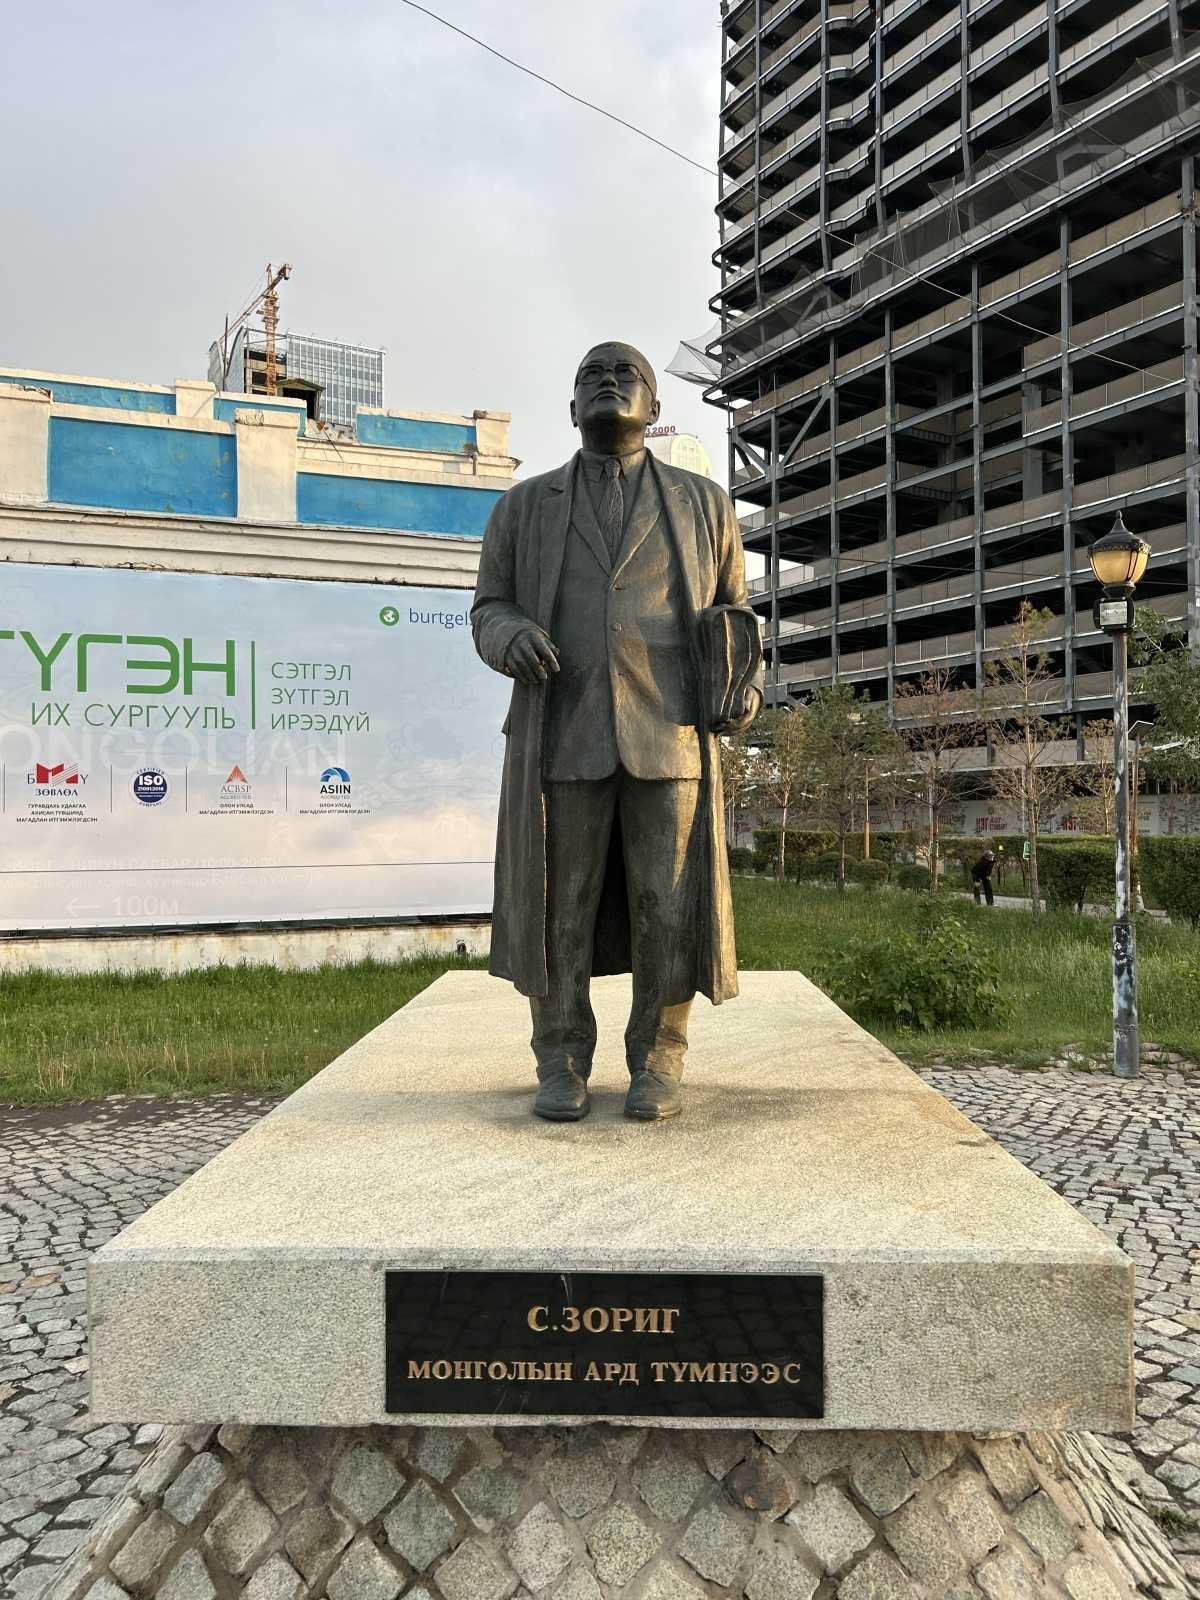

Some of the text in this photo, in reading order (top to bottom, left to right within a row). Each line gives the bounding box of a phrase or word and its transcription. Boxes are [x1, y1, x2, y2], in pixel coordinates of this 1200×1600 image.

[271, 662, 351, 680] СЭТГЭЛ
[271, 688, 349, 706] ЗҮТГЭЛ
[32, 702, 236, 729] ИХ СУРГУУЛЬ
[271, 711, 370, 735] ИРЭЭДҮЙ
[139, 775, 163, 786] ISO
[220, 785, 252, 793] ACBSP
[320, 785, 351, 794] ASIIN
[36, 788, 78, 797] ЗӨВЛӨЛ
[527, 1305, 680, 1334] С.ЗОРИГ
[407, 1360, 801, 1385] МОНГОЛЫН АРД ТҮМНЭЭС
